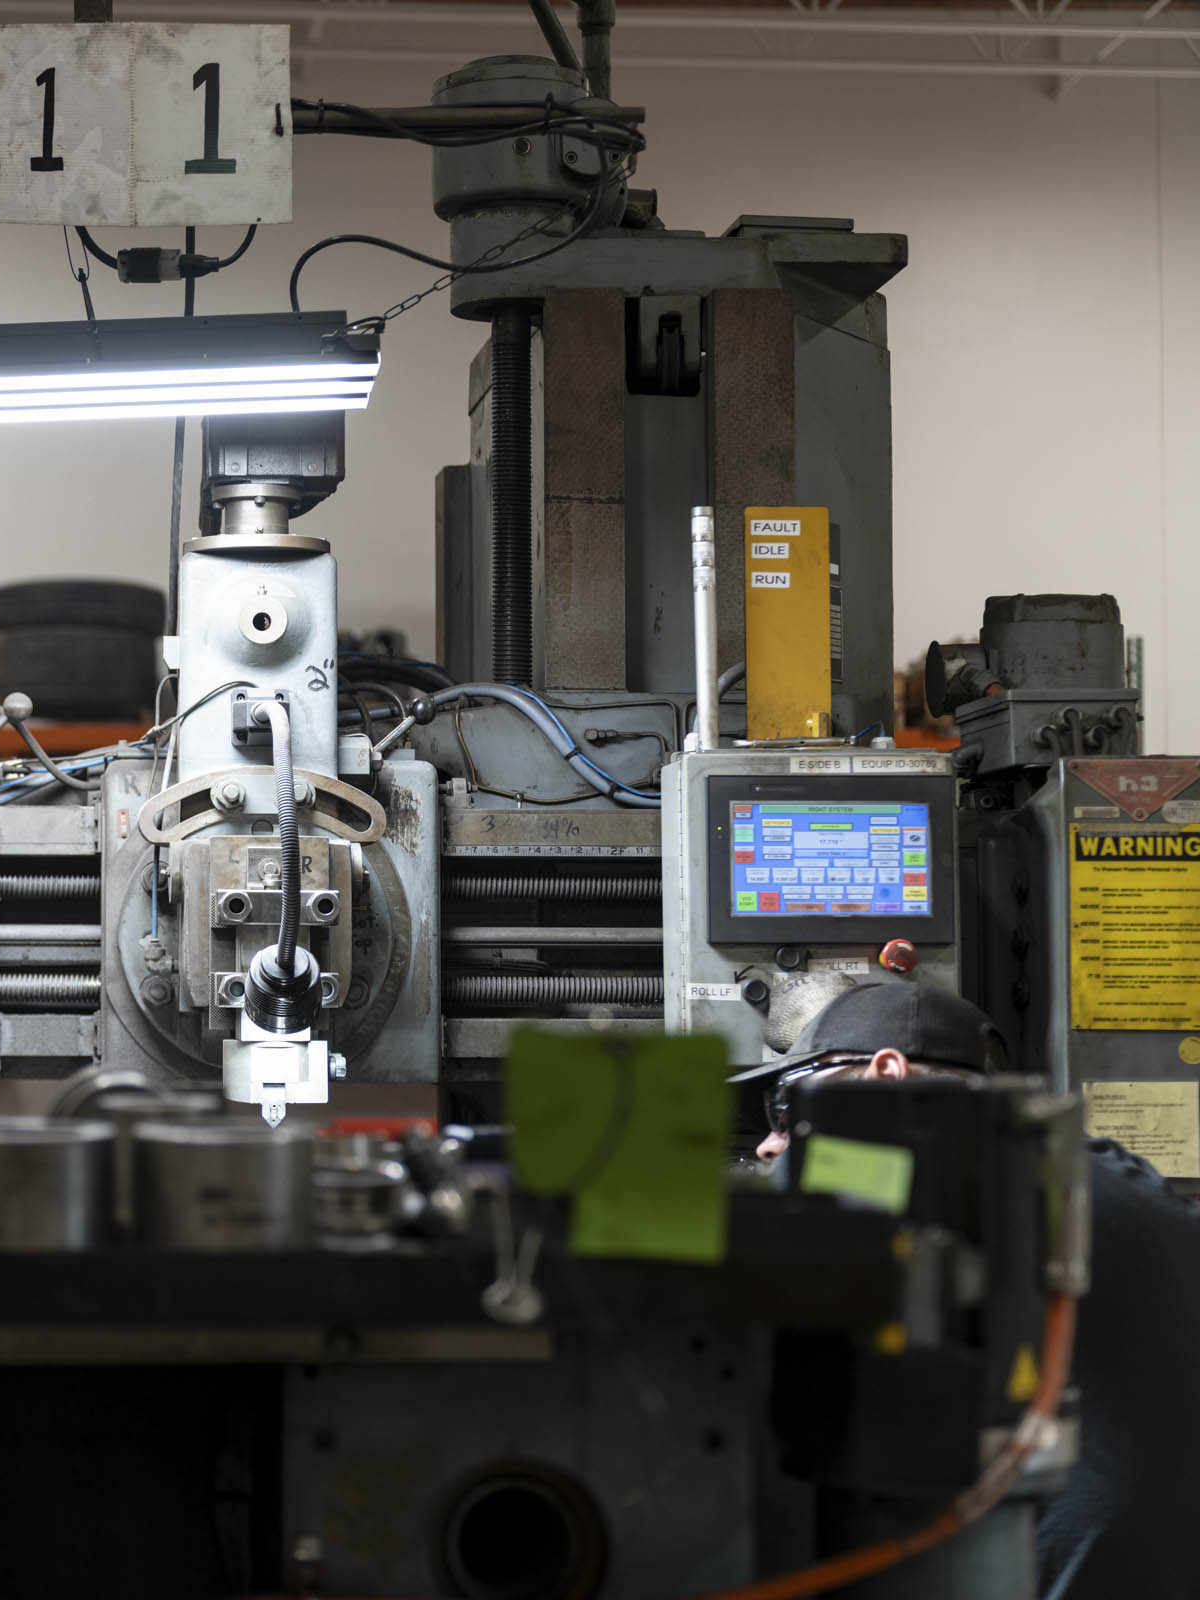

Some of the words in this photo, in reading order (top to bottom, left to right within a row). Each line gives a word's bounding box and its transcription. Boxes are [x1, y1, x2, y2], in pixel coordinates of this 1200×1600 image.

[30, 67, 64, 172] 1
[184, 62, 237, 174] 1
[753, 522, 799, 533] FAULT
[754, 545, 786, 555] IDLE
[754, 574, 787, 585] RUN
[807, 760, 832, 769] SIDE
[834, 760, 841, 769] B
[861, 760, 893, 769] EQUIP
[1079, 837, 1200, 856] WARNING
[845, 960, 859, 971] RT
[690, 986, 716, 997] ROLL
[719, 987, 732, 997] LF
